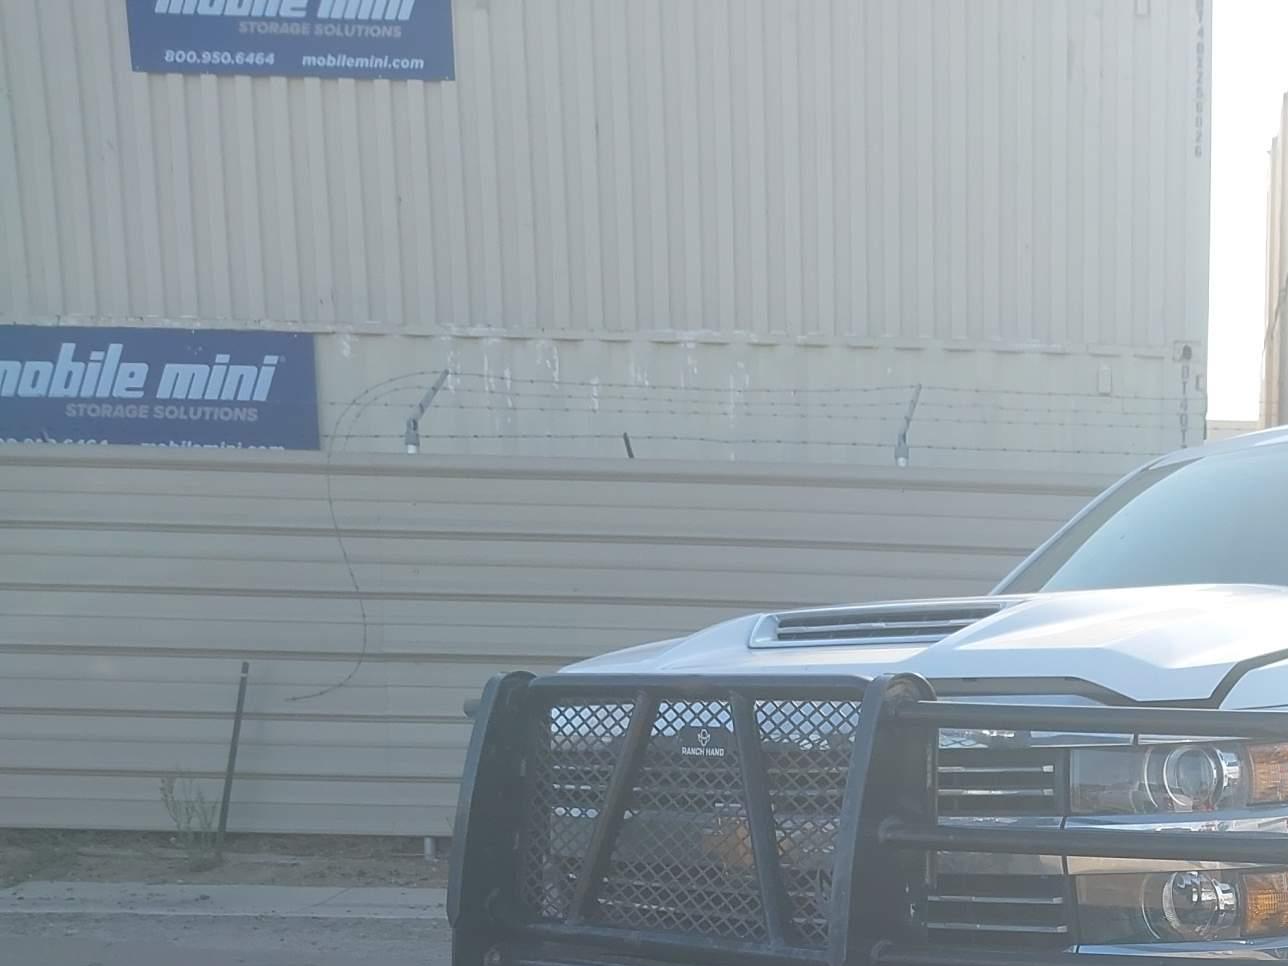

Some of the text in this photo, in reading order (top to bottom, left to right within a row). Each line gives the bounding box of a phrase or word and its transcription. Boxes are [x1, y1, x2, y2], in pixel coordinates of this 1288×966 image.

[239, 20, 402, 38] STORAGE SOLUTIONS
[164, 49, 275, 66] 800.950.6464
[301, 54, 424, 70] mobilemini.com
[156, 354, 279, 401] mini
[65, 402, 259, 422] STORAGE SOLUTIONS
[682, 747, 725, 757] RANCH HAND
